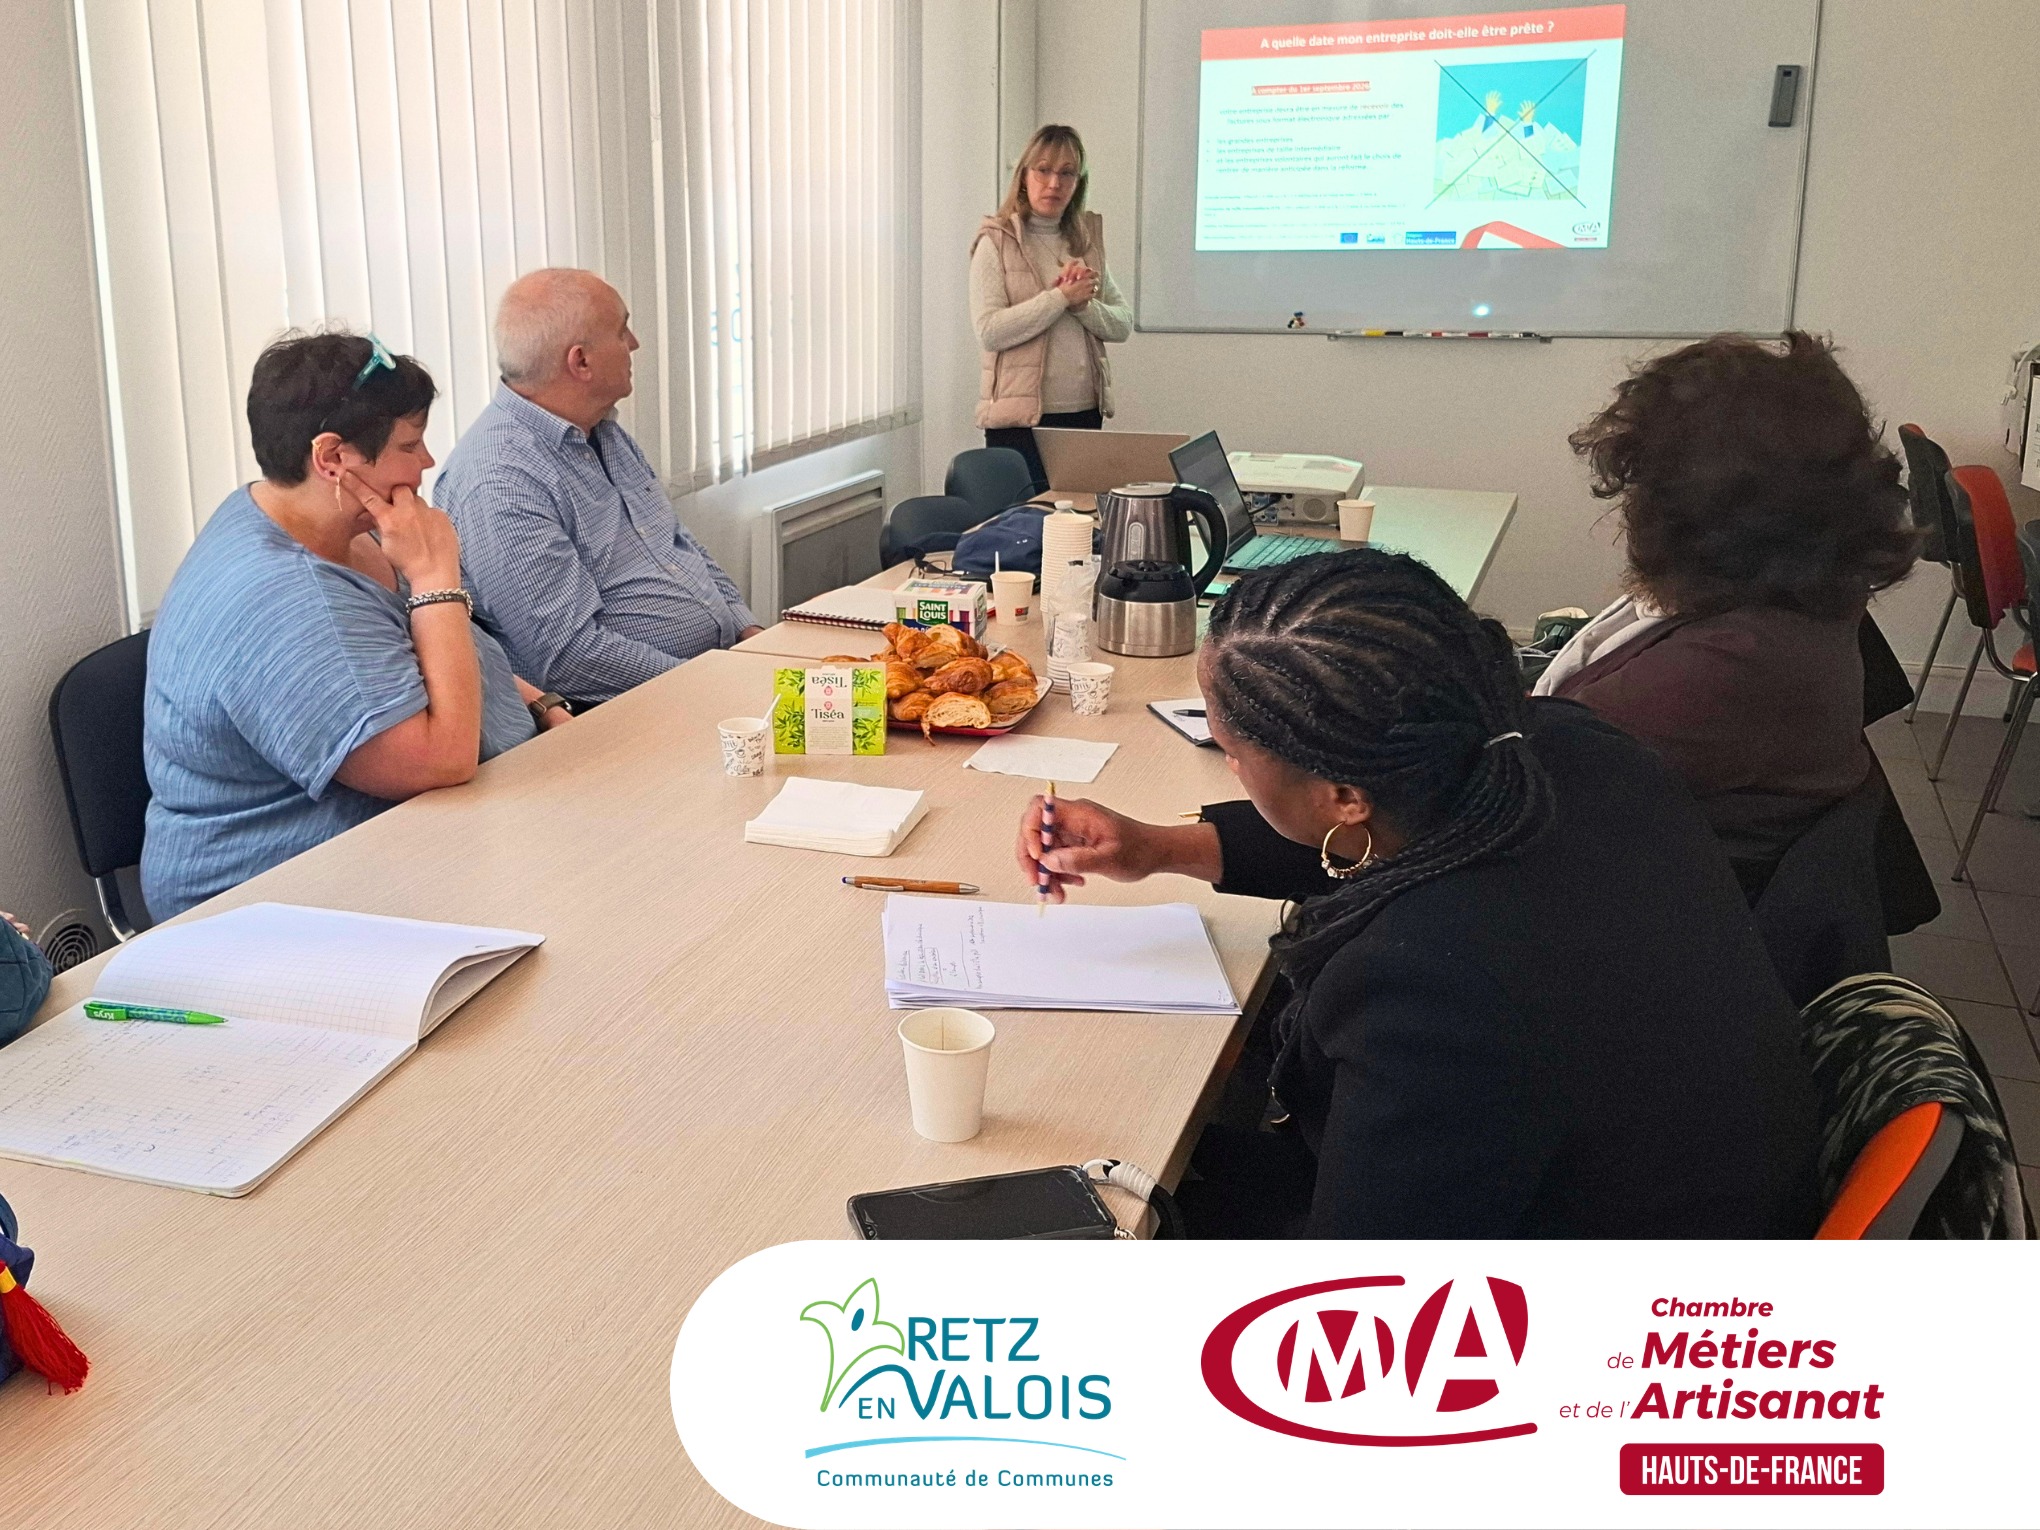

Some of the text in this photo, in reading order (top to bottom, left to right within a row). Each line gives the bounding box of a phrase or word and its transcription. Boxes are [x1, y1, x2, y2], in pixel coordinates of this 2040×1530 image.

[1272, 35, 1306, 50] quelle
[1309, 34, 1334, 47] date
[1337, 34, 1363, 45] mon
[1366, 29, 1426, 44] entreprise
[1429, 26, 1479, 40] doit-elle
[1482, 24, 1507, 37] être
[1510, 22, 1543, 37] prête
[919, 601, 947, 611] SAINT
[919, 610, 947, 620] LOUIS
[811, 676, 847, 688] Tiséa
[811, 708, 845, 719] Tiséa
[93, 1010, 115, 1021] Krys
